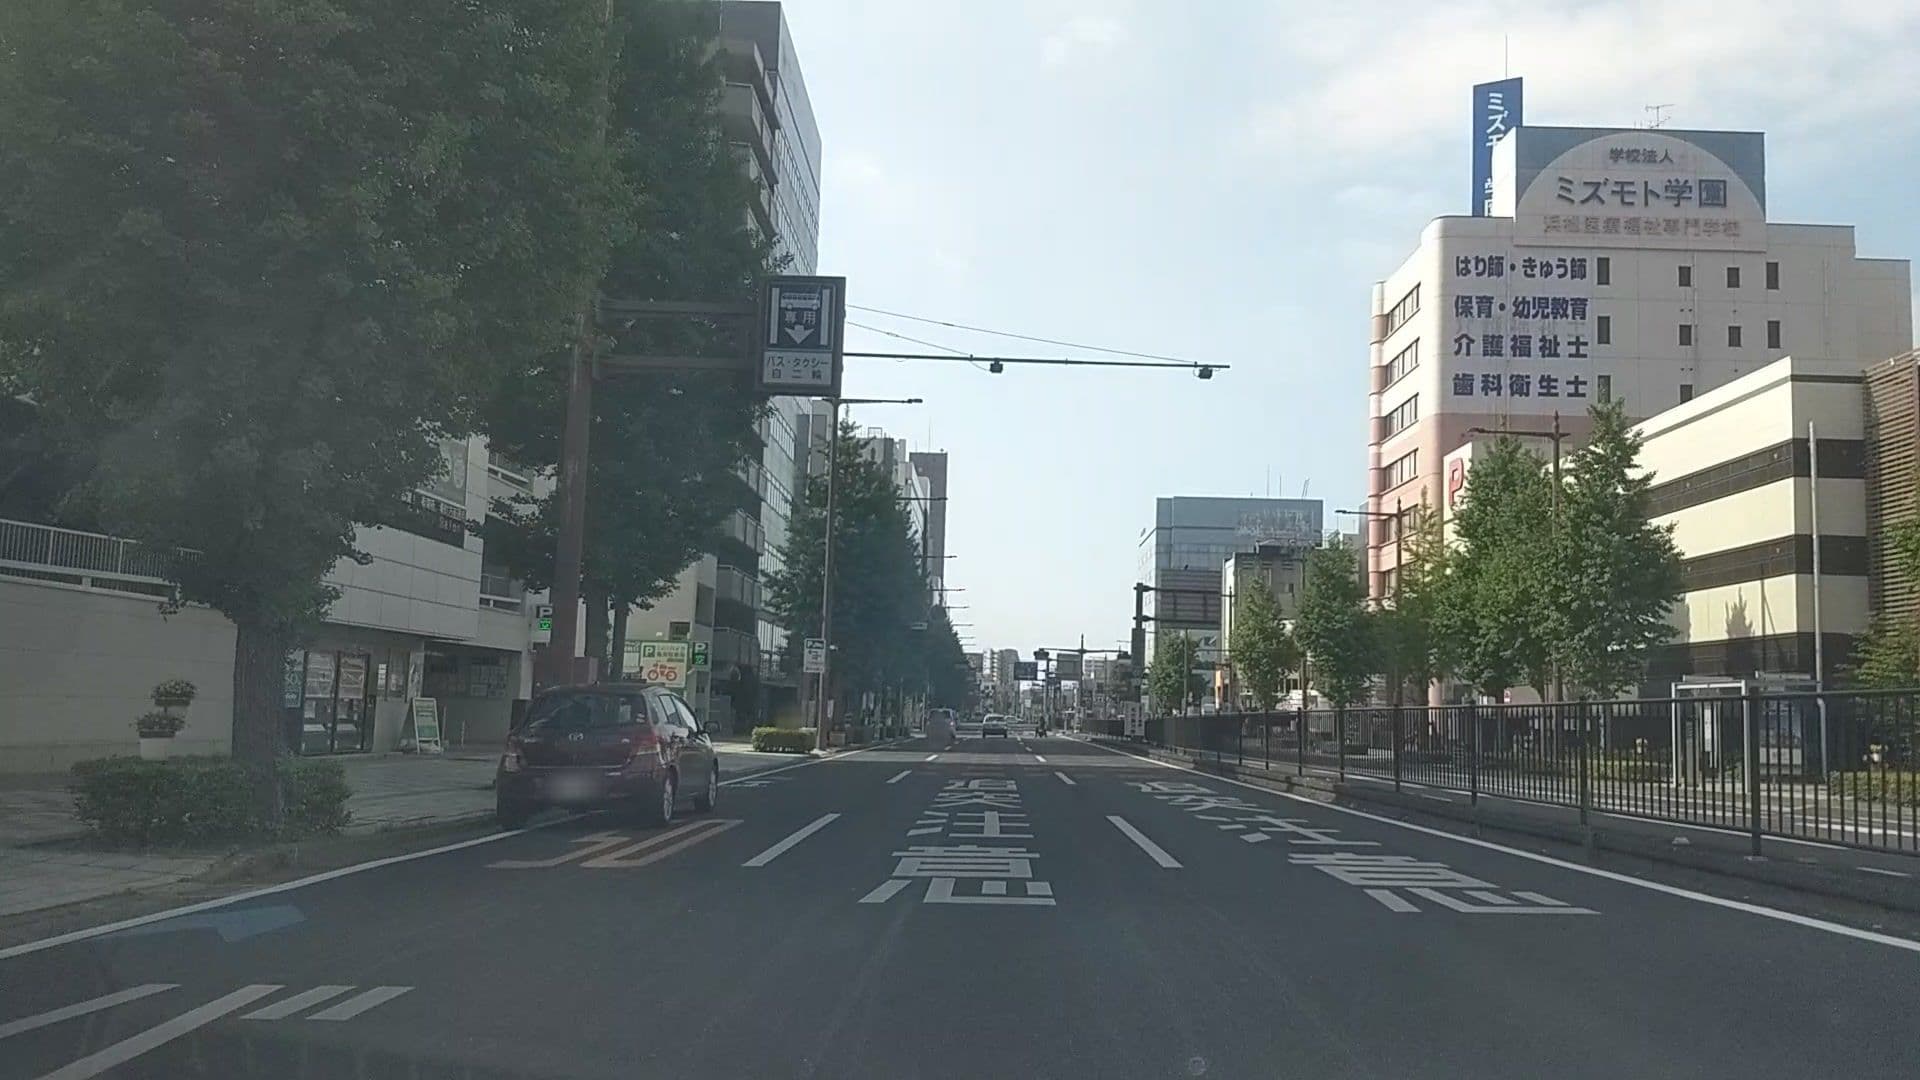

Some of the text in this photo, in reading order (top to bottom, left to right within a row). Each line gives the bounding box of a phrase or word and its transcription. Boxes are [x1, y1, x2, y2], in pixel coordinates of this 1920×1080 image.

[1609, 148, 1674, 164] 学校法人
[1556, 176, 1728, 208] ミズモト学園
[1455, 255, 1588, 280] はり師・きゅう師
[784, 311, 816, 325] 専用
[1454, 294, 1589, 320] 保育・幼児教育
[1453, 333, 1589, 358] 介護福祉士
[767, 356, 830, 368] バス・タクシー
[1453, 373, 1588, 397] 歯科衛生士
[1448, 457, 1464, 507] P
[539, 606, 553, 617] P
[644, 646, 655, 657] P
[695, 643, 706, 653] P
[857, 778, 1057, 905] 追突注意
[1123, 781, 1601, 914] 追突注意
